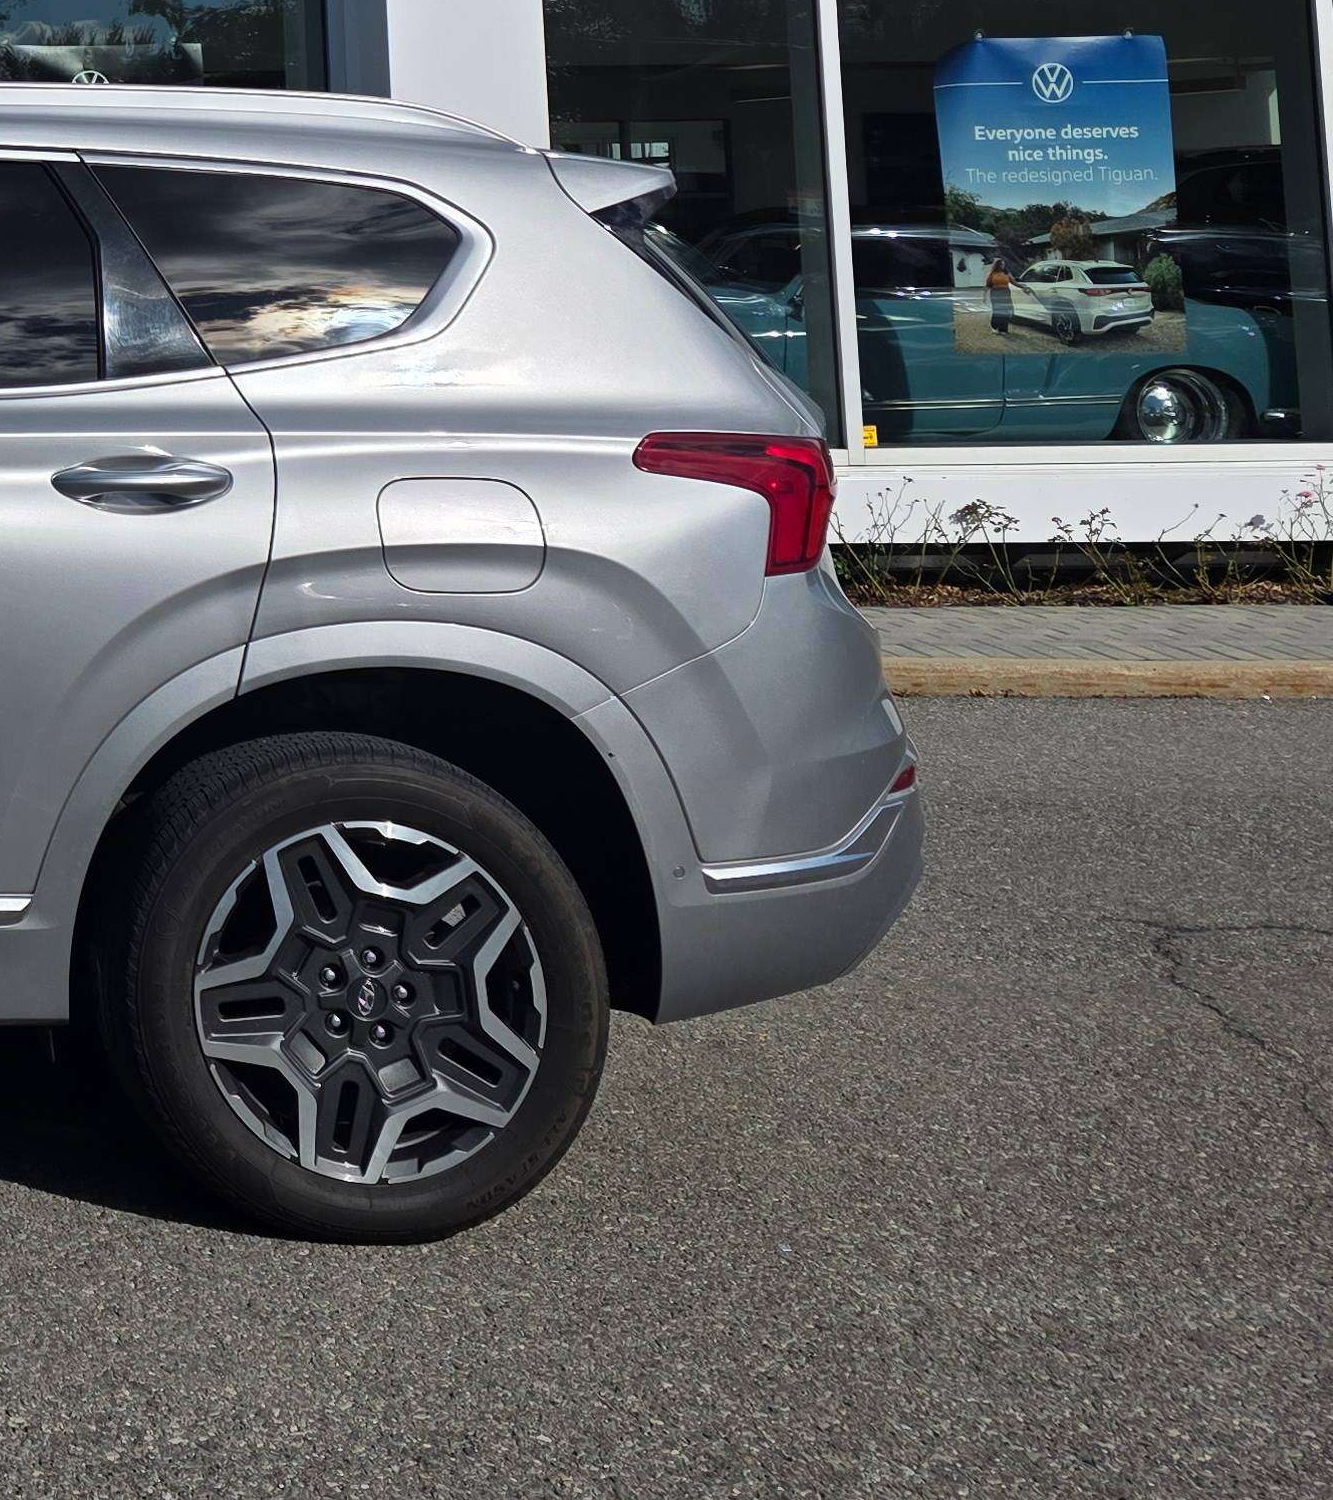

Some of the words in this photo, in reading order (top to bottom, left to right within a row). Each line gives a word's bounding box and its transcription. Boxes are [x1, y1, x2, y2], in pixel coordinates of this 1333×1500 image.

[974, 125, 1057, 143] Everyone
[1061, 124, 1139, 140] deserves
[1008, 146, 1043, 162] nice
[1046, 145, 1108, 164] things.
[965, 168, 997, 184] The
[1002, 167, 1093, 186] redesigned
[1098, 166, 1159, 185] Tiguan.
